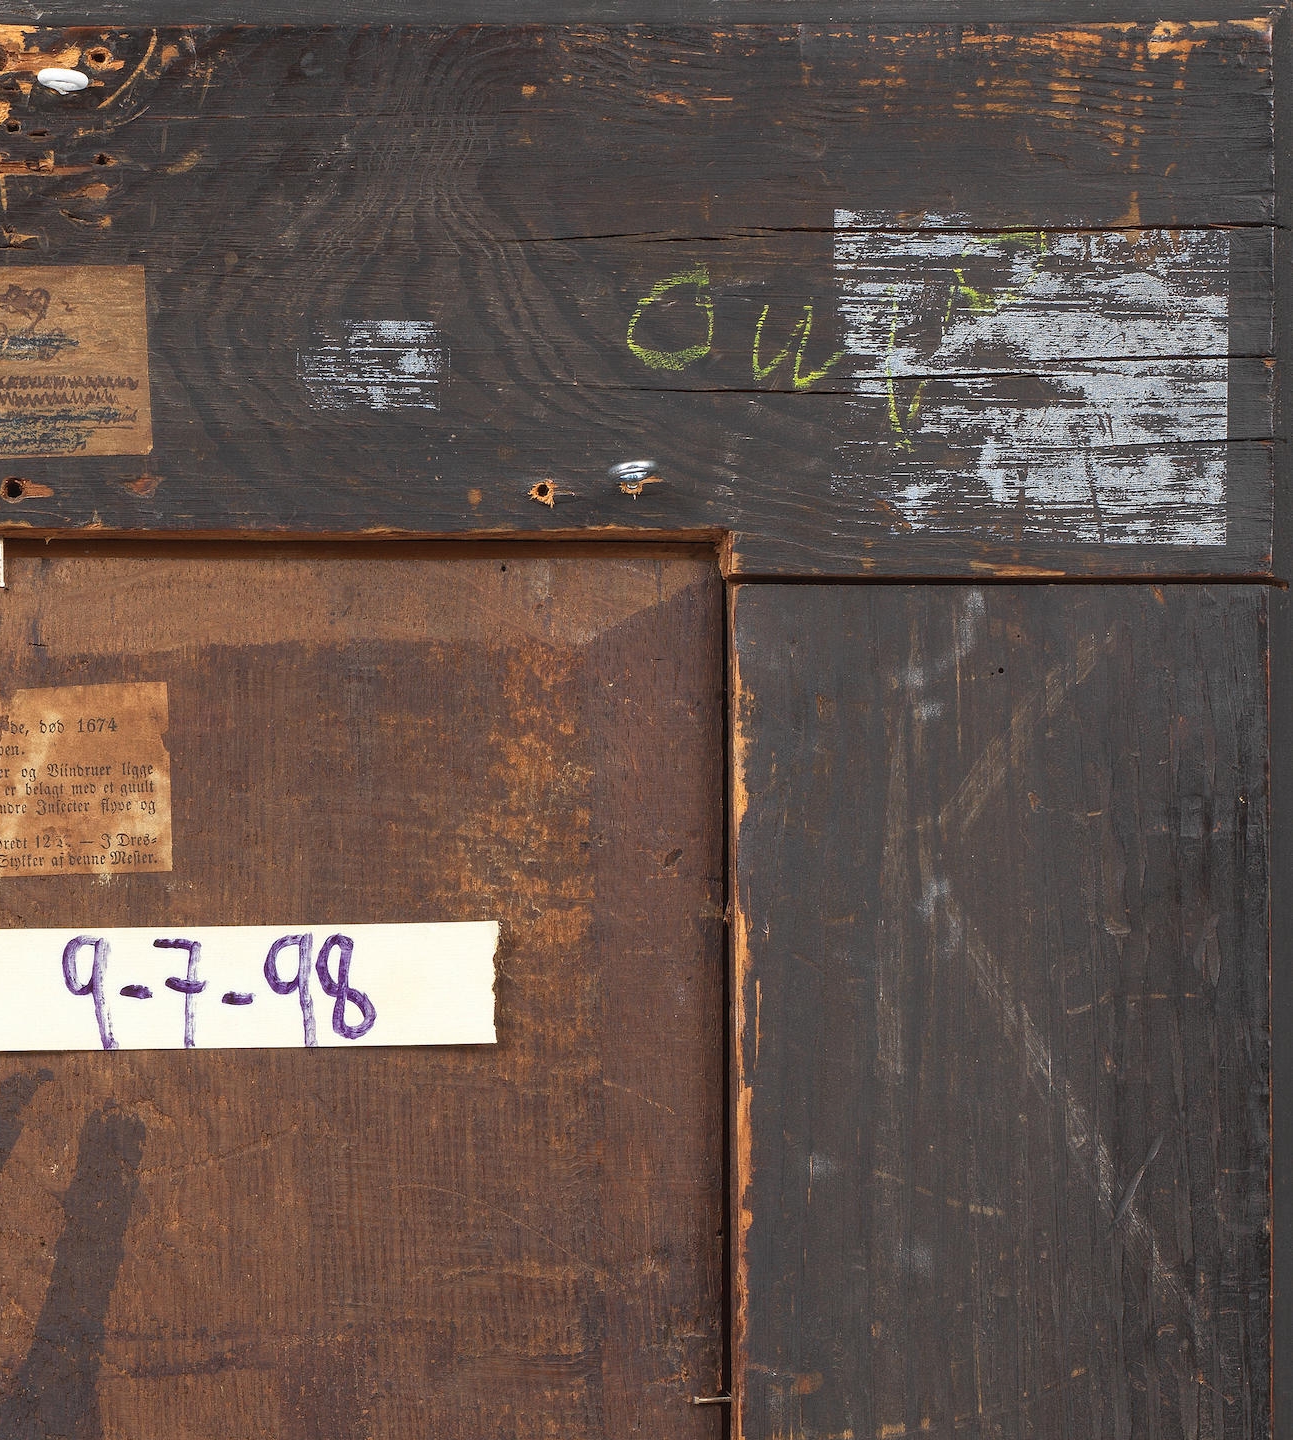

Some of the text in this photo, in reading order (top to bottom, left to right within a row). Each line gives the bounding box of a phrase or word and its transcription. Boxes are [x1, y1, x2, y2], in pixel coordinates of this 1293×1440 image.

[77, 718, 117, 733] 1674
[22, 768, 36, 781] og
[123, 762, 153, 778] ligge
[5, 785, 17, 796] er
[26, 781, 65, 798] belagt
[72, 783, 96, 795] med
[104, 782, 114, 793] et
[141, 800, 156, 815] og
[35, 835, 50, 848] 12
[52, 853, 64, 868] af
[68, 854, 106, 865] denne
[63, 933, 377, 1049] 9-7-98
